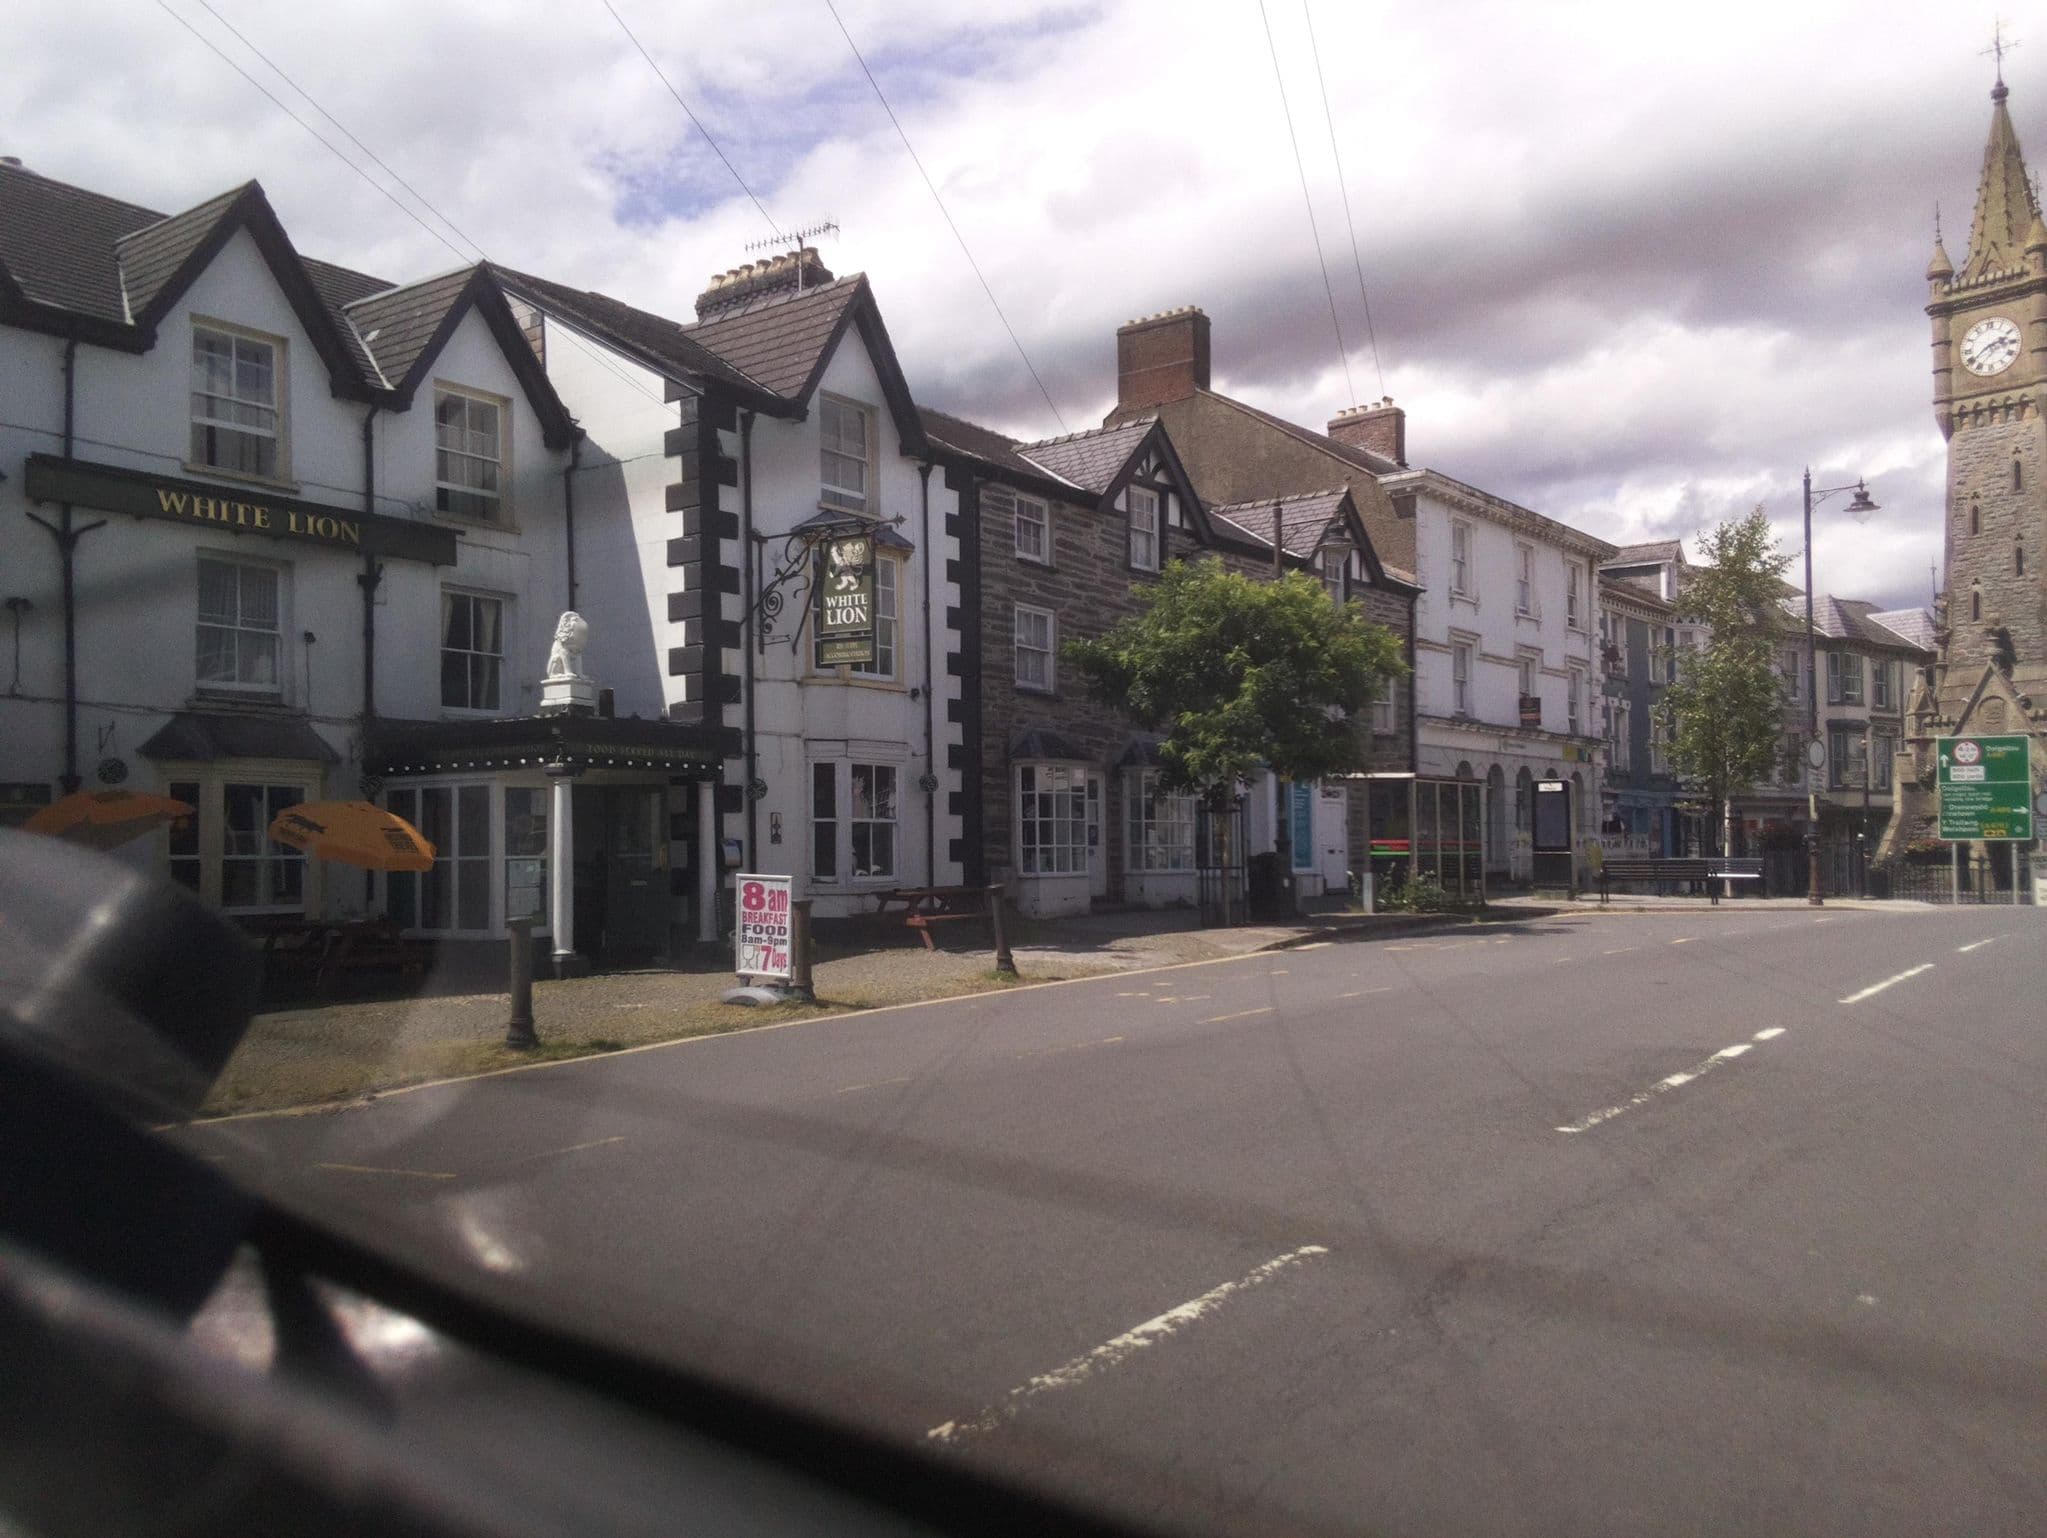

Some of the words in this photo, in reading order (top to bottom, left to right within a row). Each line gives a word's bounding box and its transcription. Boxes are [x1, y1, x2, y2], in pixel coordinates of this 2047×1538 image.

[155, 488, 271, 529] WHITE
[287, 511, 361, 545] LION
[826, 593, 868, 608] WHITE
[827, 607, 867, 625] LION
[743, 882, 766, 911] 8
[768, 889, 788, 912] am
[742, 911, 788, 925] BREAKFAST
[742, 924, 788, 936] FOOD
[742, 935, 788, 946] 8am-9pm
[760, 945, 772, 971] 7
